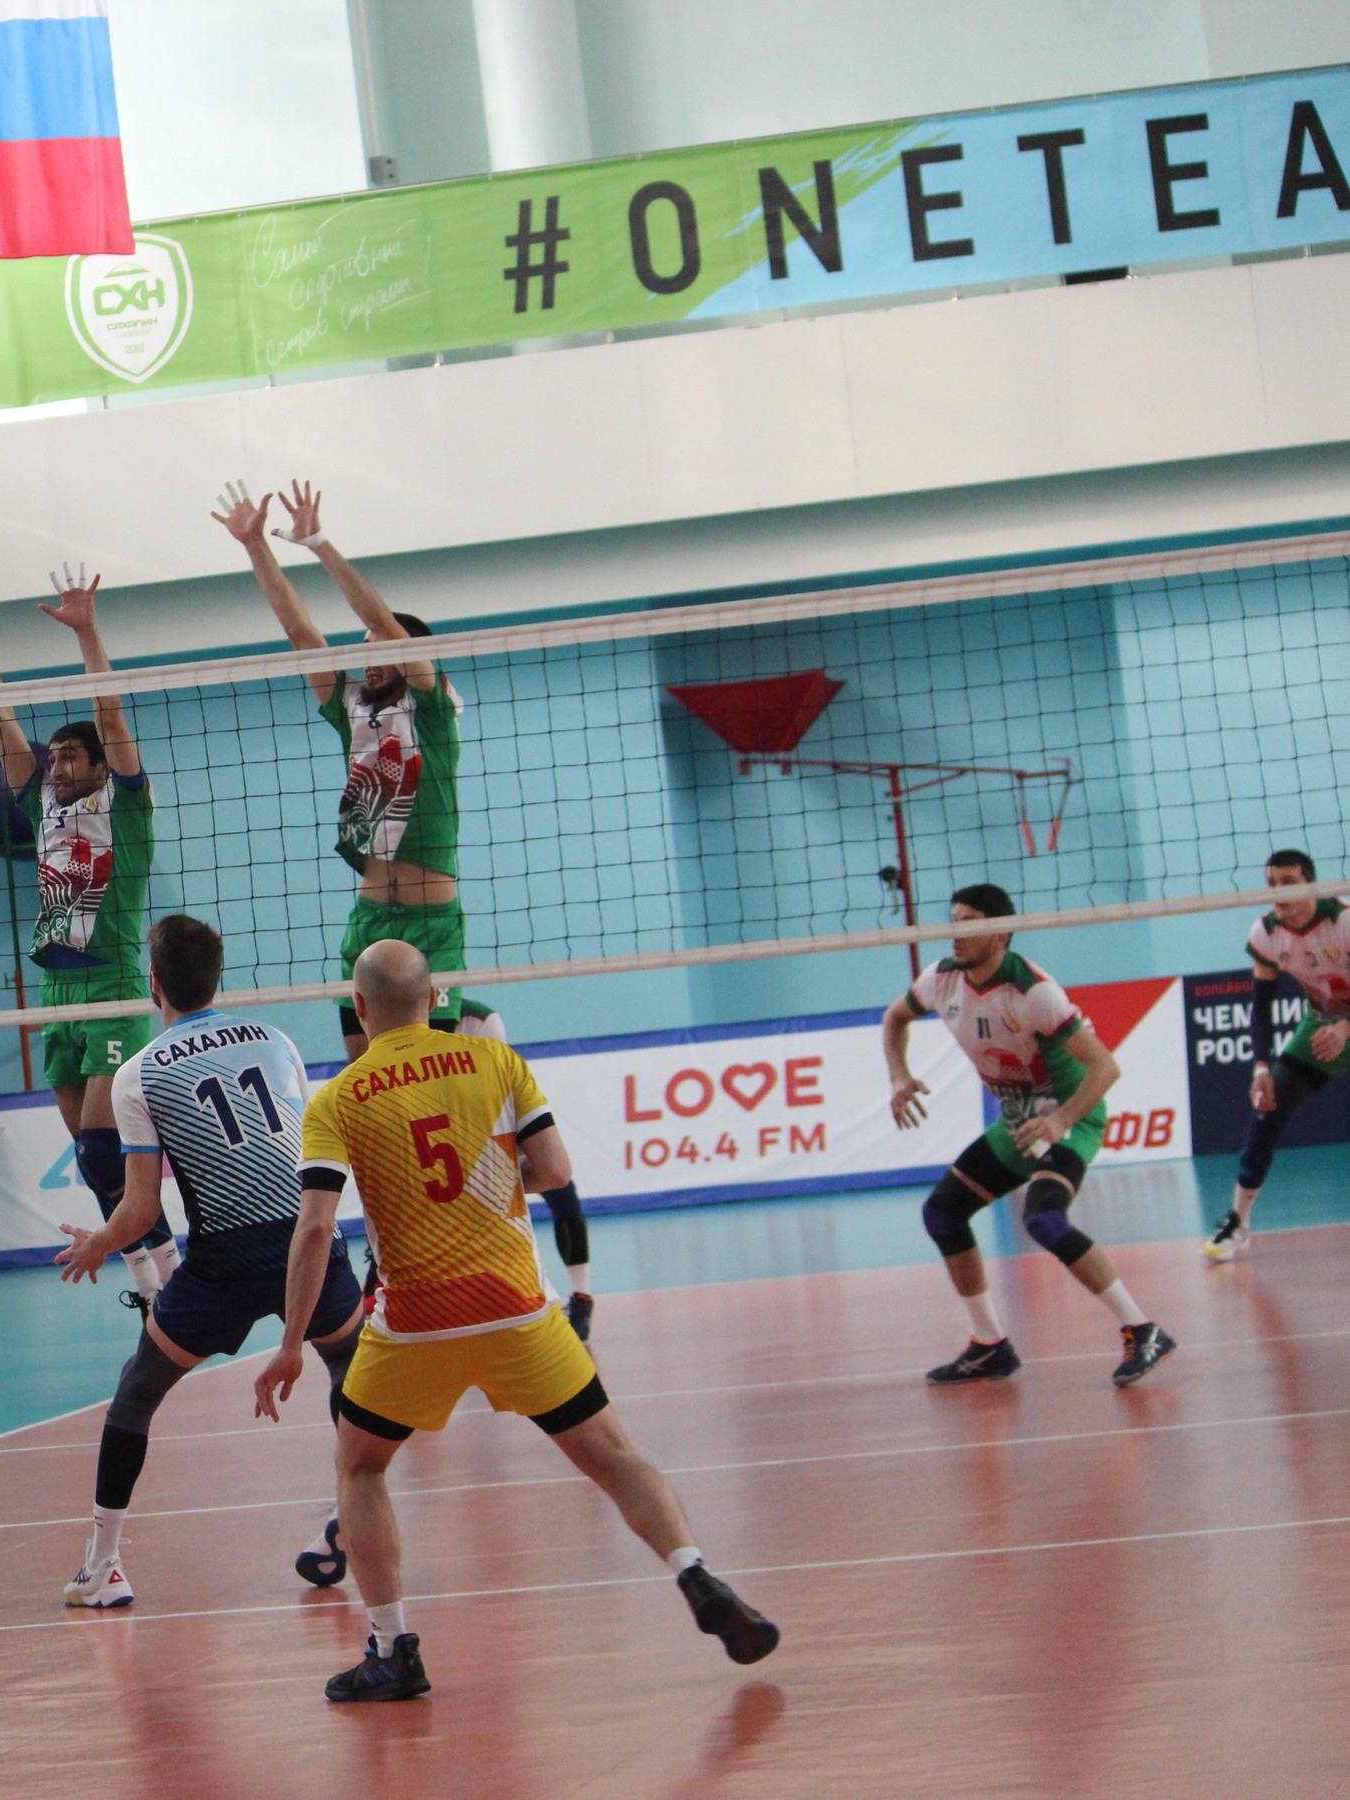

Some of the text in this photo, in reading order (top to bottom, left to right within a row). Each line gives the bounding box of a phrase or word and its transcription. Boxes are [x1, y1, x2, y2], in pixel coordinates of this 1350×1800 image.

[154, 1025, 269, 1067] САХАЛИН
[977, 1017, 992, 1039] 11
[107, 1041, 122, 1064] 5
[352, 1051, 477, 1102] САХАЛИН
[196, 1066, 284, 1147] 11
[626, 1123, 826, 1170] 104.4 FM
[1102, 1109, 1175, 1150] ФВ
[410, 1113, 464, 1203] 5
